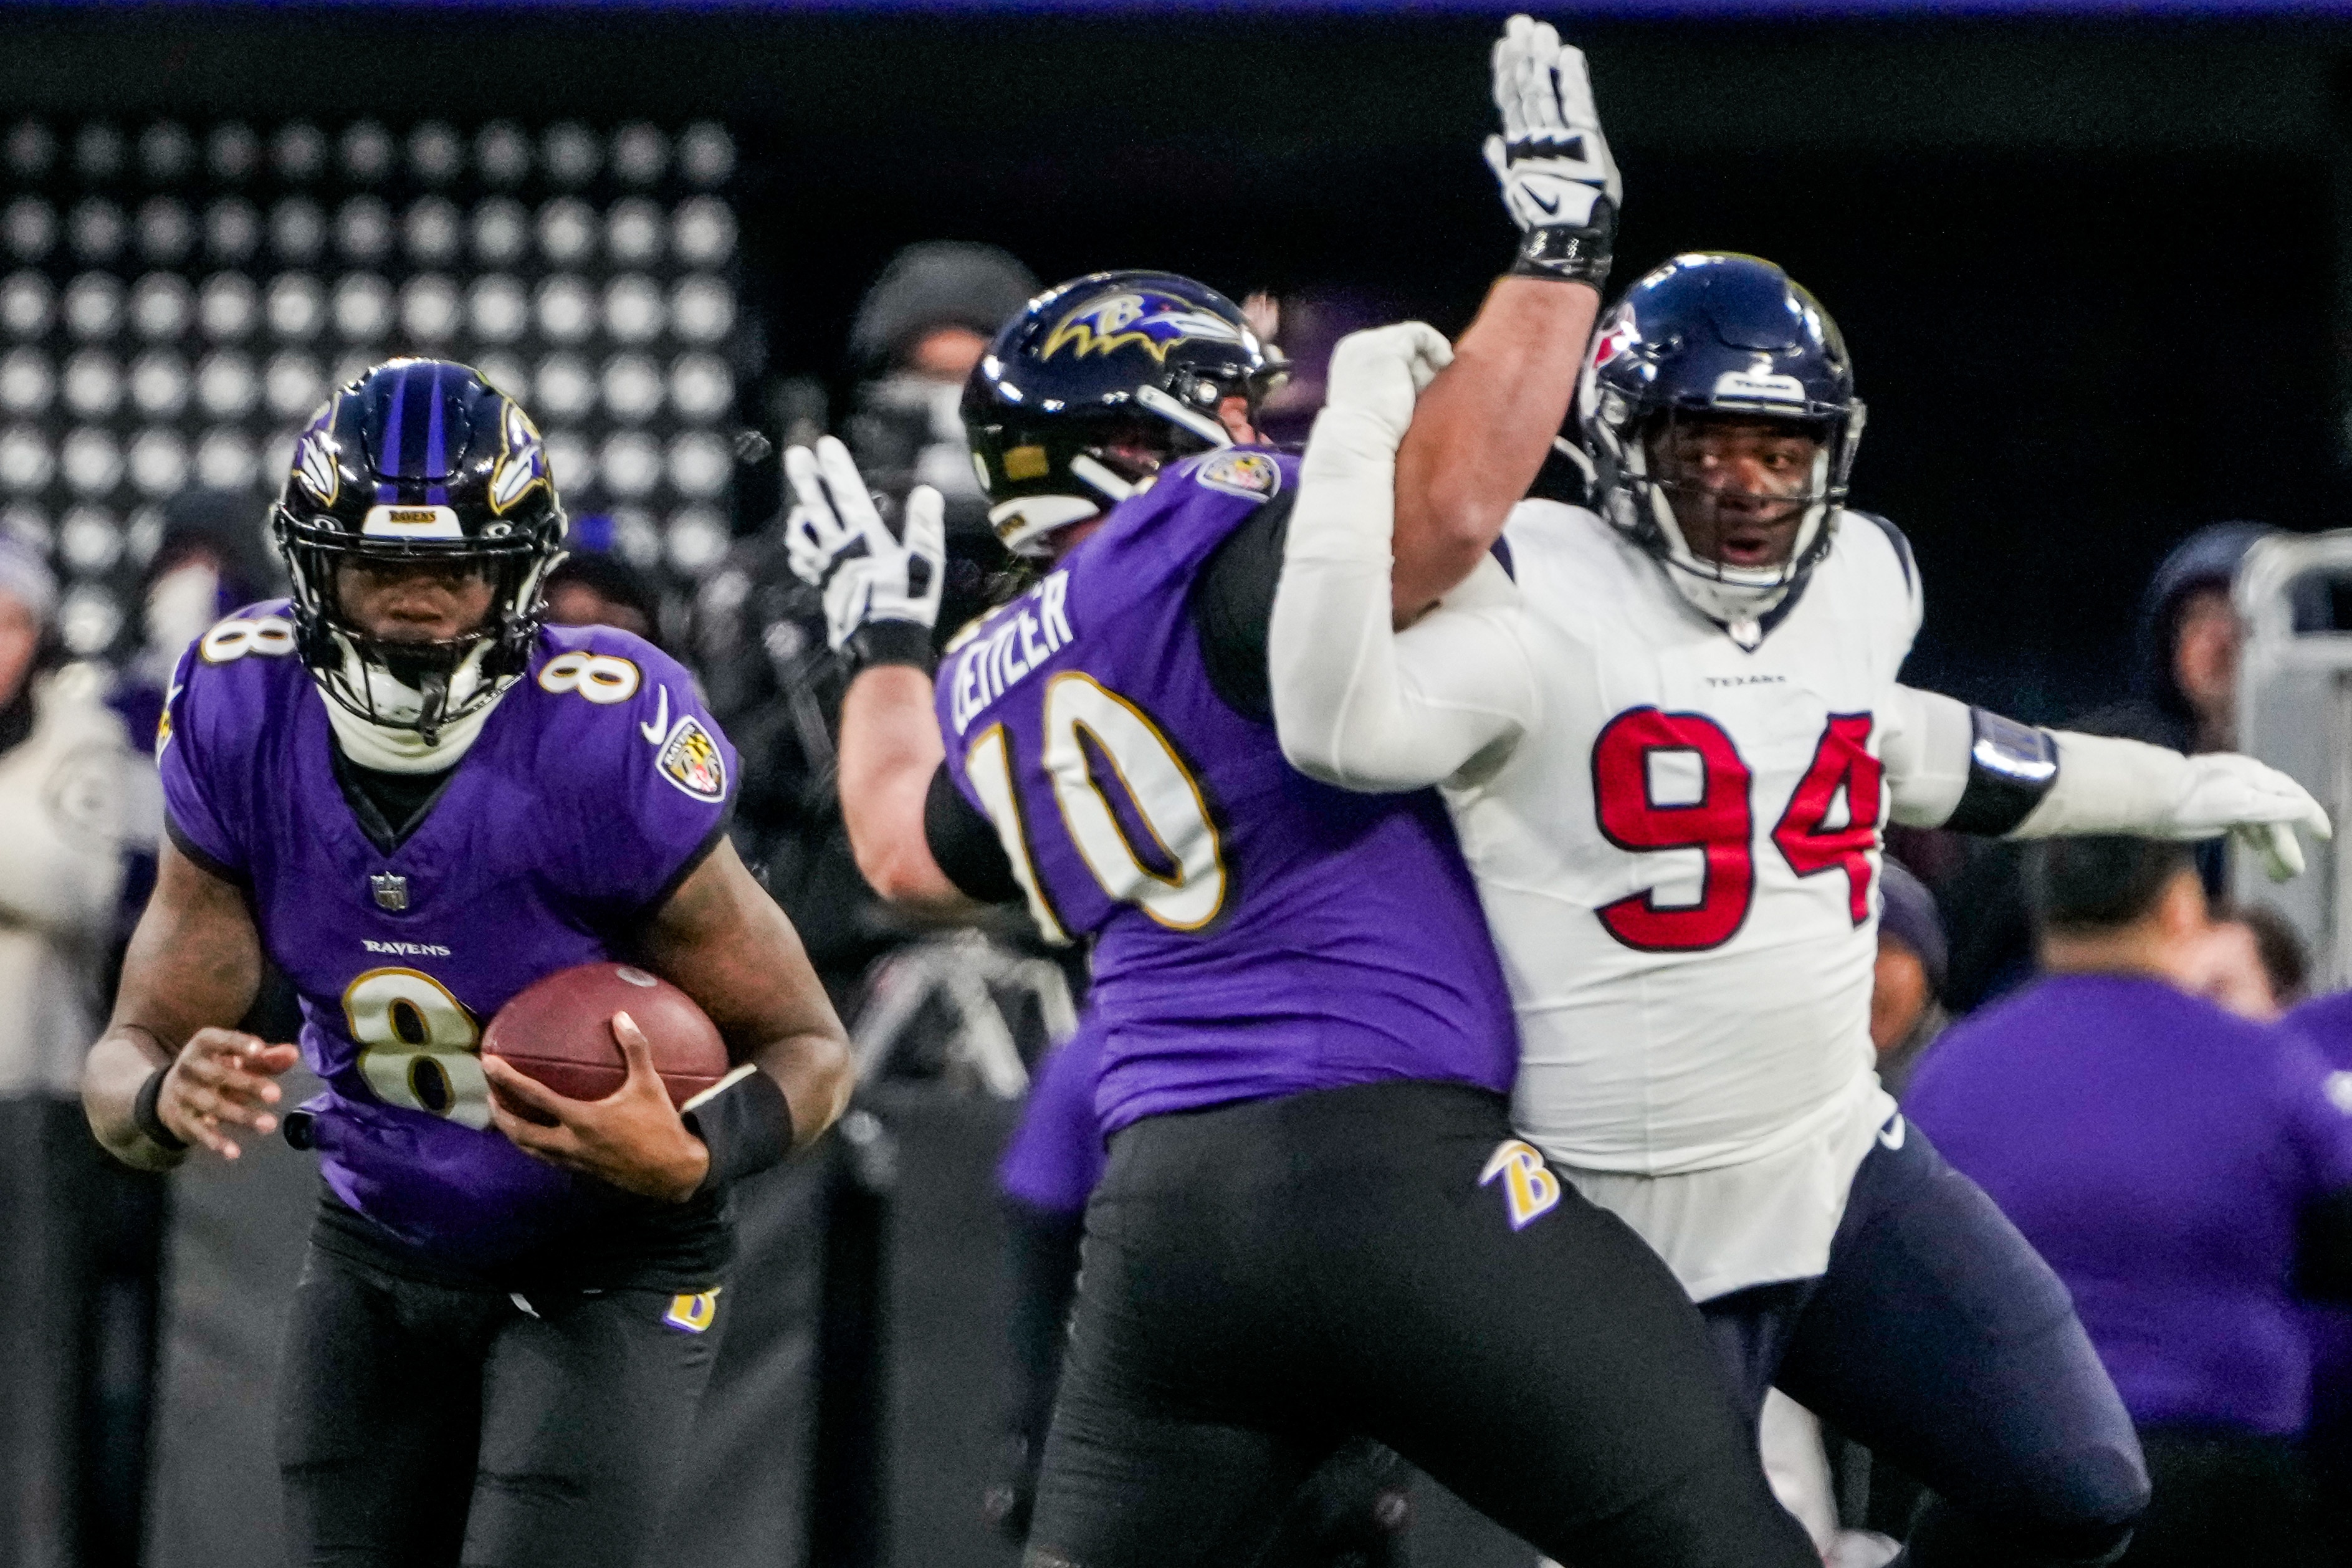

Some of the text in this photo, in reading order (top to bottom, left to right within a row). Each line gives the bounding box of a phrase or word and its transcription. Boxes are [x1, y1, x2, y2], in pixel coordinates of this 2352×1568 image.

[200, 616, 297, 664] 8
[538, 651, 643, 705] 8
[1704, 674, 1787, 687] TEXANS
[1590, 704, 1885, 953] 94
[361, 939, 451, 957] RAVENS
[342, 966, 492, 1131] 8
